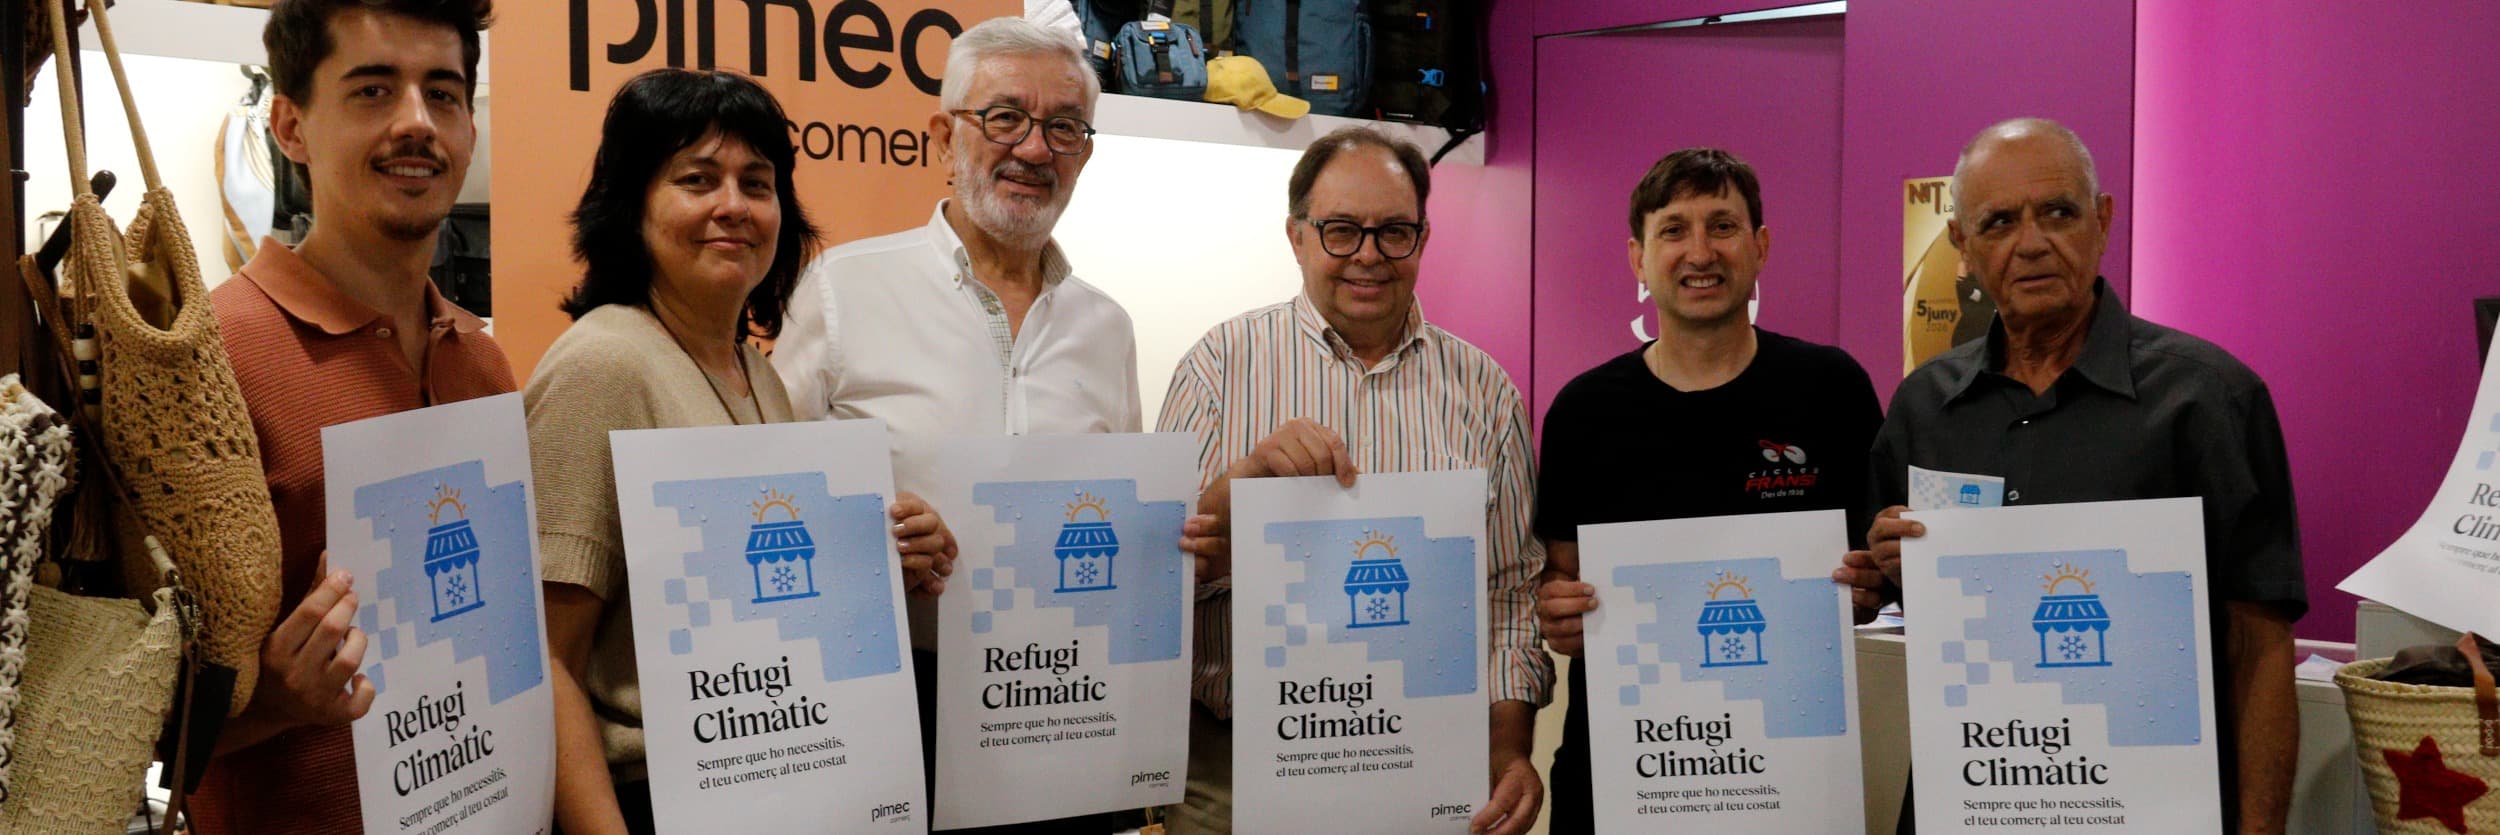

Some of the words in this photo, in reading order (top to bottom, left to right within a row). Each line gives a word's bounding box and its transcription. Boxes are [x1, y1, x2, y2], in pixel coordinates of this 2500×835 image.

[786, 119, 932, 168] omer
[1908, 181, 1945, 215] NIT
[1917, 299, 1927, 316] 5
[1927, 306, 1957, 322] juny
[983, 639, 1079, 675] Refugi
[687, 656, 793, 701] Refugi
[982, 674, 1107, 710] Climàtic
[1278, 673, 1373, 708] Refugi
[385, 681, 466, 748] Refugi
[693, 695, 829, 743] Climàtic
[980, 719, 1022, 736] Sempre
[1024, 718, 1045, 731] que
[1047, 716, 1062, 727] ho
[1277, 708, 1402, 741] Climàtic
[1633, 712, 1733, 747] Refugi
[980, 736, 990, 748] el
[992, 736, 1009, 747] teu
[1011, 734, 1052, 746] comerç
[1053, 730, 1064, 742] al
[1065, 730, 1083, 740] teu
[1084, 726, 1116, 739] costat
[1961, 717, 2071, 755] Refugi
[393, 725, 495, 797] Climàtic
[697, 752, 743, 772] Sempre
[745, 749, 768, 766] que
[769, 746, 784, 759] ho
[1276, 751, 1318, 764] Sempre
[1320, 749, 1341, 761] que
[1342, 747, 1358, 759] ho
[1276, 766, 1286, 778] el
[1288, 766, 1305, 777] teu
[1307, 764, 1349, 775] comerç
[1350, 761, 1360, 773] al
[1362, 762, 1380, 772] teu
[1381, 759, 1414, 771] costat
[1635, 747, 1766, 778] Climàtic
[1963, 756, 2109, 786] Climàtic
[699, 774, 711, 790] el
[712, 772, 732, 787] teu
[733, 766, 778, 783] comerç
[779, 762, 791, 775] al
[792, 760, 811, 774] teu
[812, 754, 847, 769] costat
[1131, 771, 1170, 786] pimec
[459, 806, 468, 820] al
[469, 801, 482, 816] teu
[483, 787, 509, 808] costat
[1636, 789, 1680, 801] Sempre
[1681, 788, 1702, 800] que
[1705, 786, 1719, 797] ho
[1637, 804, 1648, 815] el
[1649, 804, 1668, 814] teu
[1669, 803, 1711, 814] comerç
[1713, 800, 1724, 812] al
[1726, 801, 1744, 811] teu
[1746, 799, 1781, 810] costat
[1963, 799, 2011, 812] Sempre
[2014, 800, 2038, 812] que
[2040, 798, 2056, 809] ho
[400, 806, 432, 831] Sempre
[434, 795, 449, 814] que
[450, 790, 463, 804] ho
[871, 801, 910, 822] pimec
[1431, 803, 1471, 819] pimec
[1964, 815, 1975, 826] el
[1977, 816, 1997, 826] teu
[2000, 816, 2047, 827] comerç
[2050, 814, 2061, 825] al
[2064, 816, 2084, 825] teu
[2087, 815, 2125, 825] costat
